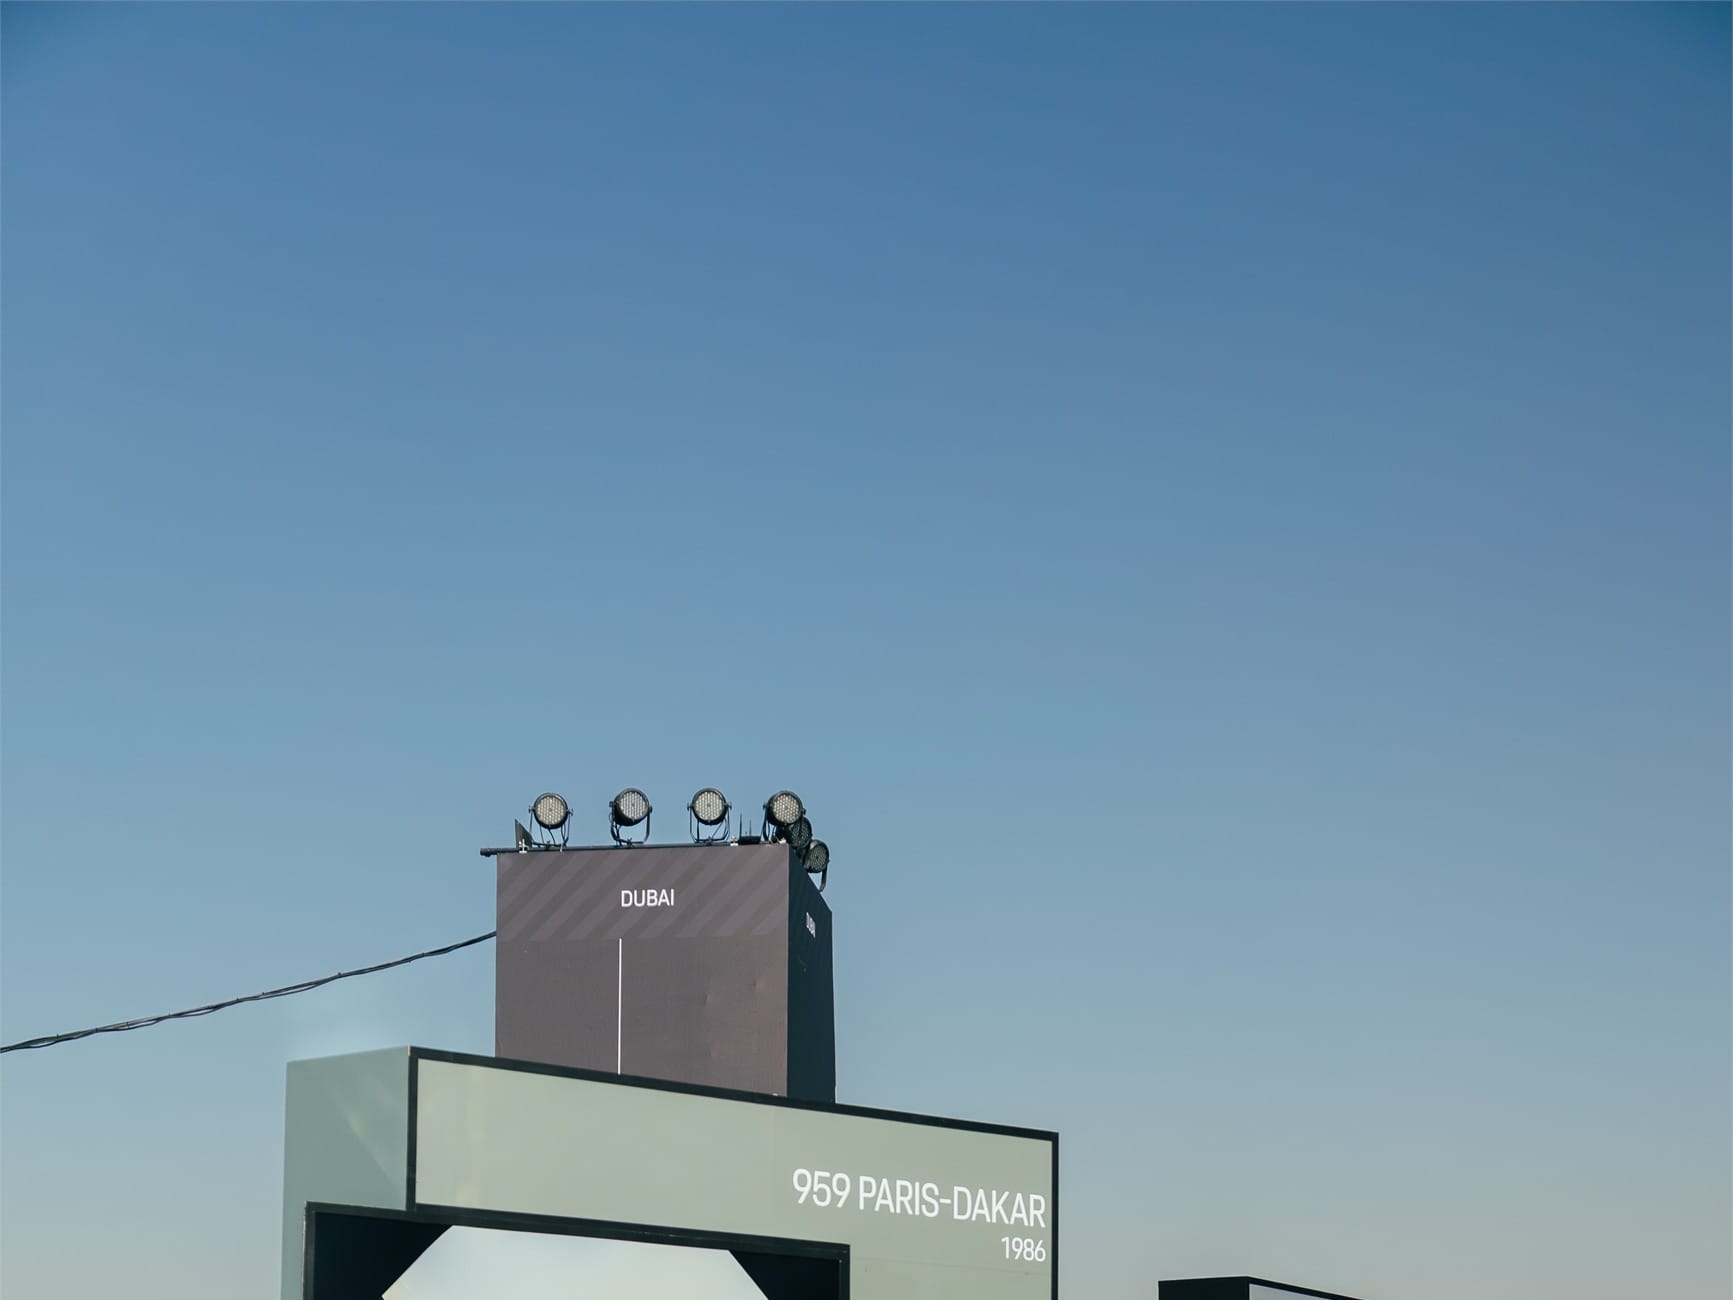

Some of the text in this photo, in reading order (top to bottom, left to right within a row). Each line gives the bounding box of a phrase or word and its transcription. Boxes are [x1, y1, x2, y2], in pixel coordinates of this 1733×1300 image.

[621, 888, 675, 907] DUBAI
[792, 1168, 1046, 1228] 959 PARIS-DAKAR
[1001, 1236, 1046, 1262] 1986
